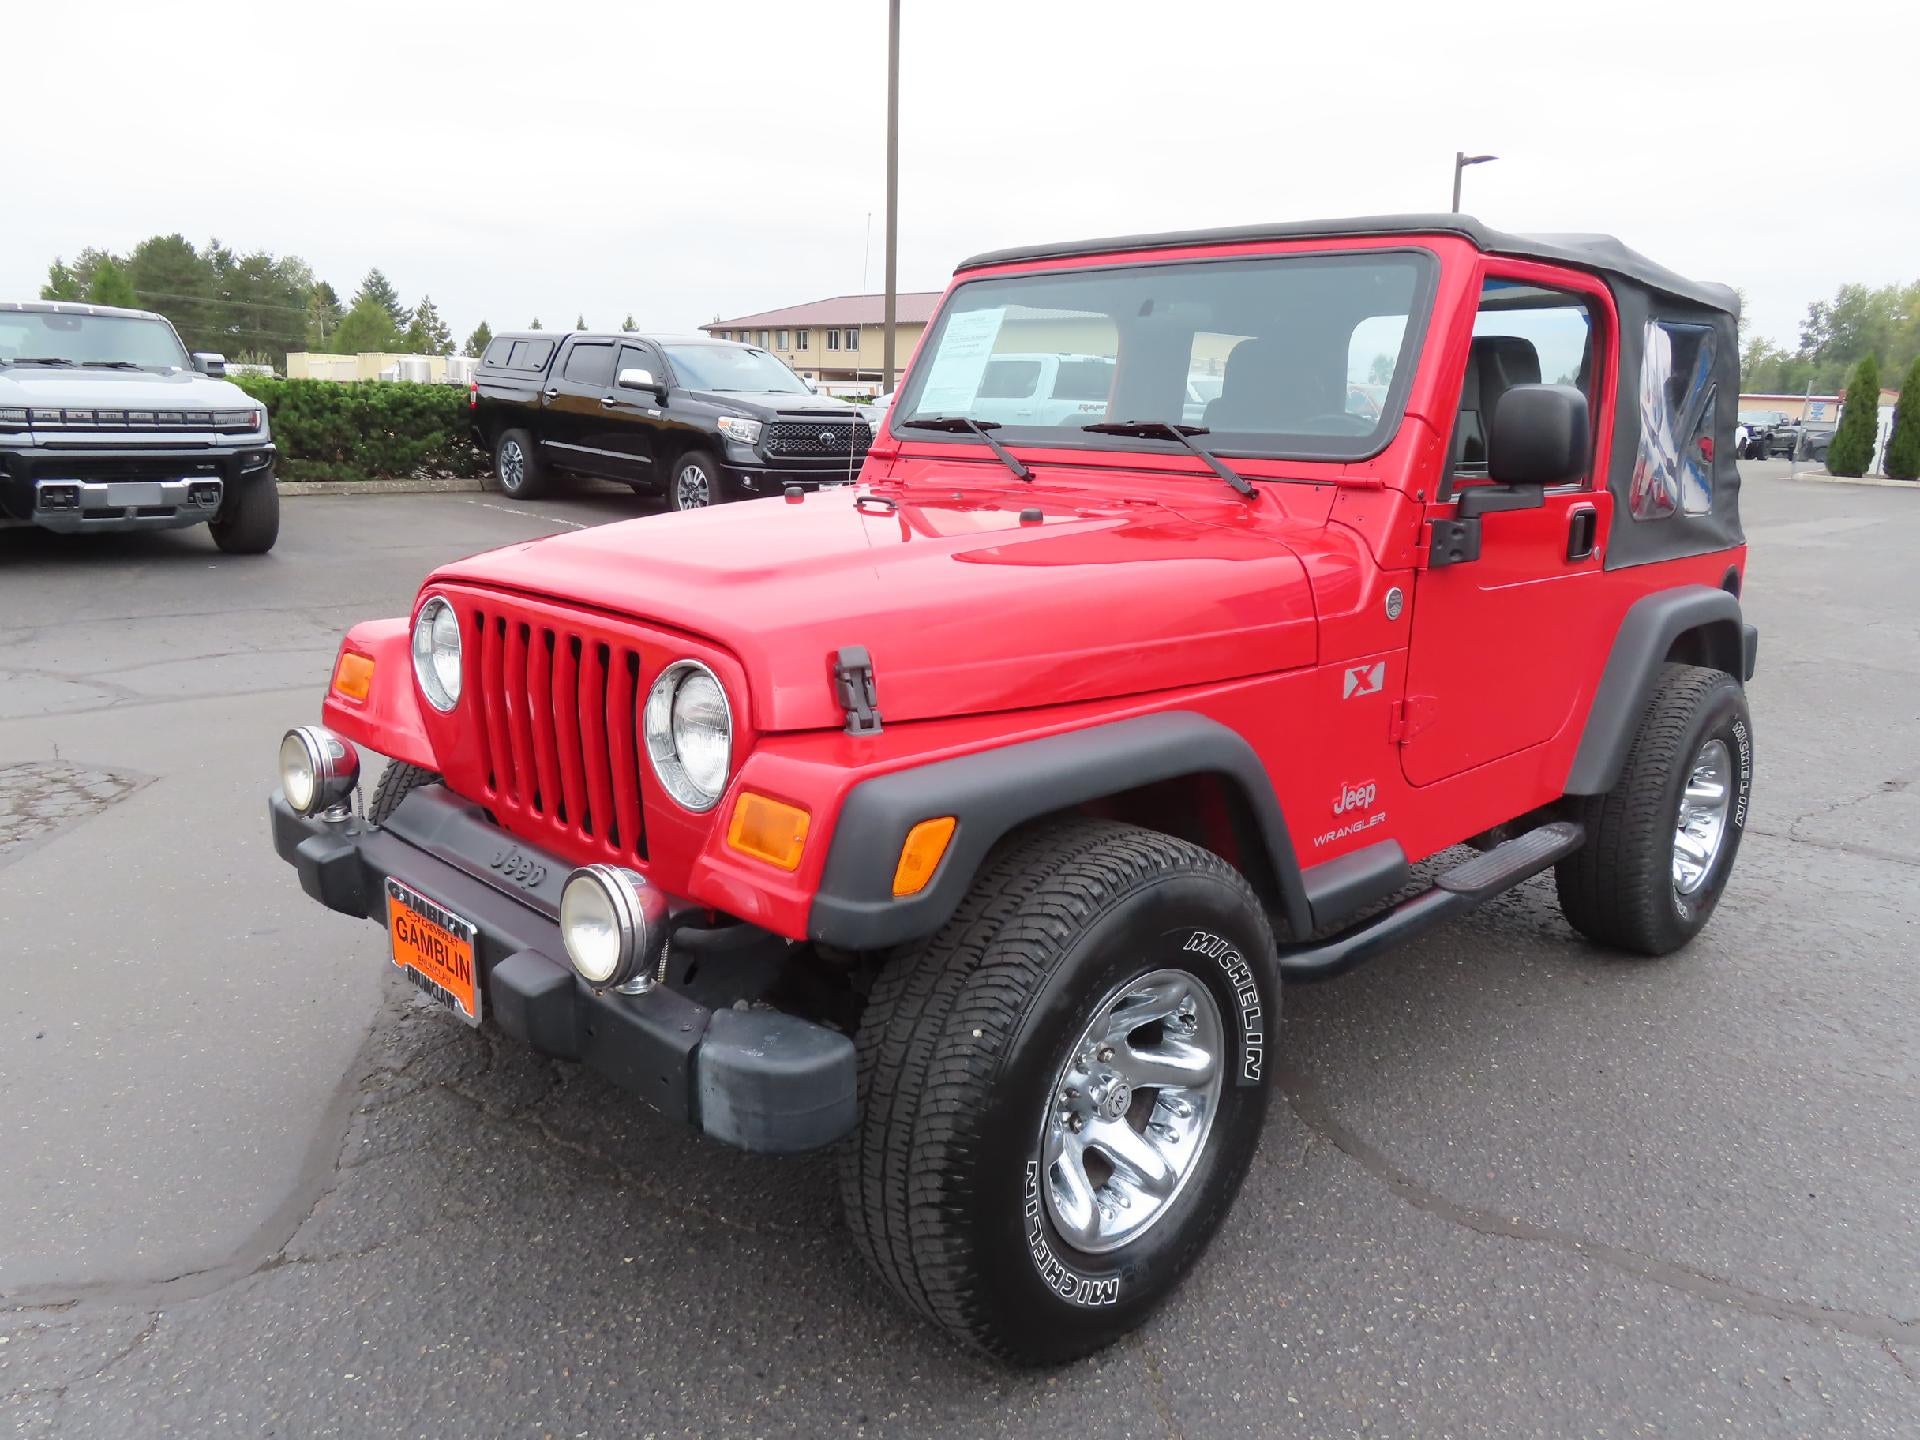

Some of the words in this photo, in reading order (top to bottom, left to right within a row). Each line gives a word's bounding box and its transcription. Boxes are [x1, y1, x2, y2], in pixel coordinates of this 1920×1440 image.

[1333, 782, 1376, 814] Jeep
[1731, 721, 1750, 828] MICHELIN
[1313, 812, 1387, 847] WRANGLER
[490, 844, 547, 890] Jeep
[395, 916, 471, 986] GAMBLIN
[1182, 930, 1264, 1082] MICHELIN
[1024, 1159, 1120, 1306] MICHELIN
